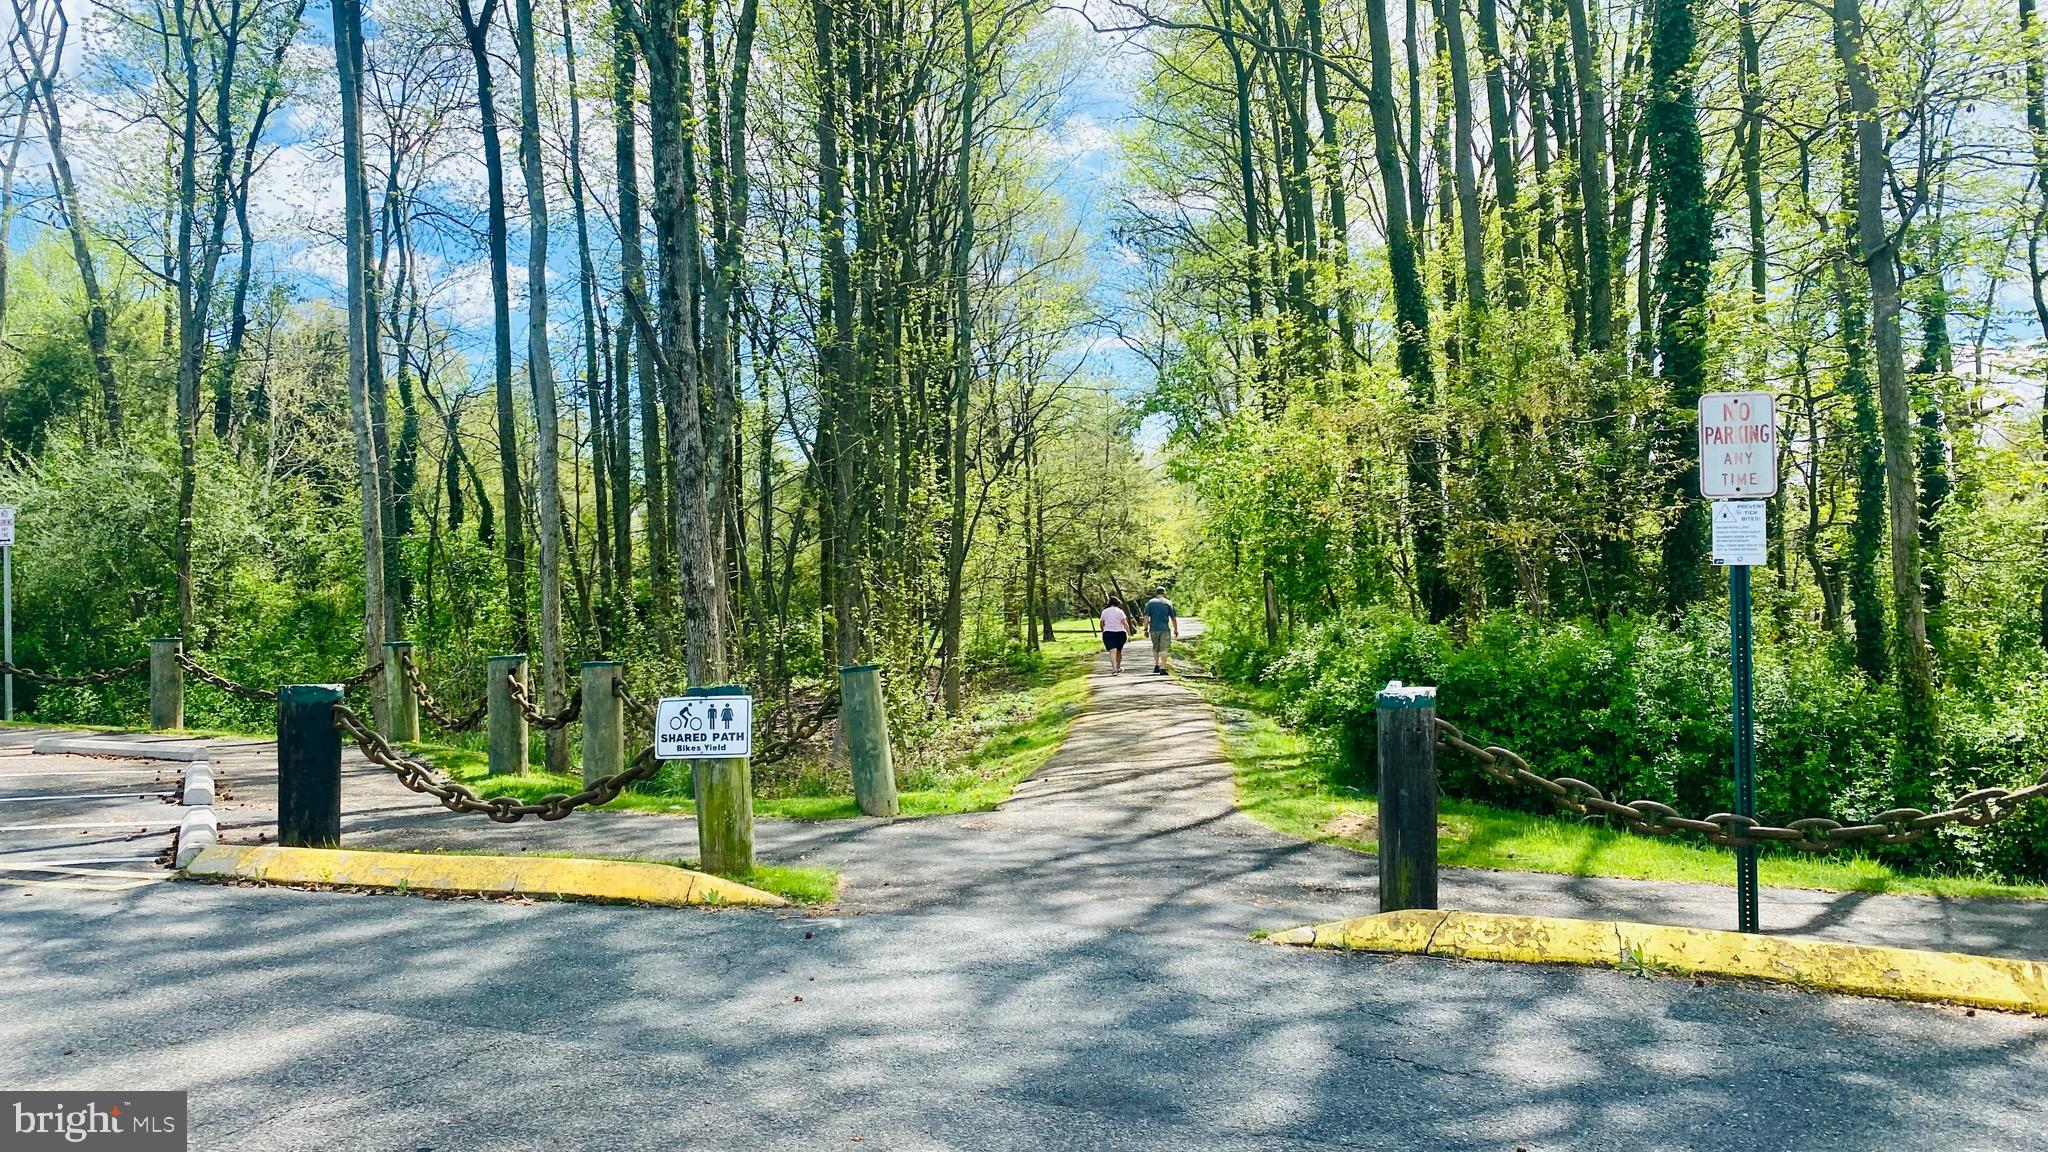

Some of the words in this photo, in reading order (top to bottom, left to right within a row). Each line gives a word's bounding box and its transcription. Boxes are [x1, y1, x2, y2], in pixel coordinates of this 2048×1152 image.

[1723, 402, 1751, 422] NO
[1705, 424, 1770, 445] PARKING
[1724, 452, 1753, 465] ANY
[1721, 473, 1758, 486] TIME
[660, 733, 707, 743] SHARED
[712, 732, 745, 742] PATH
